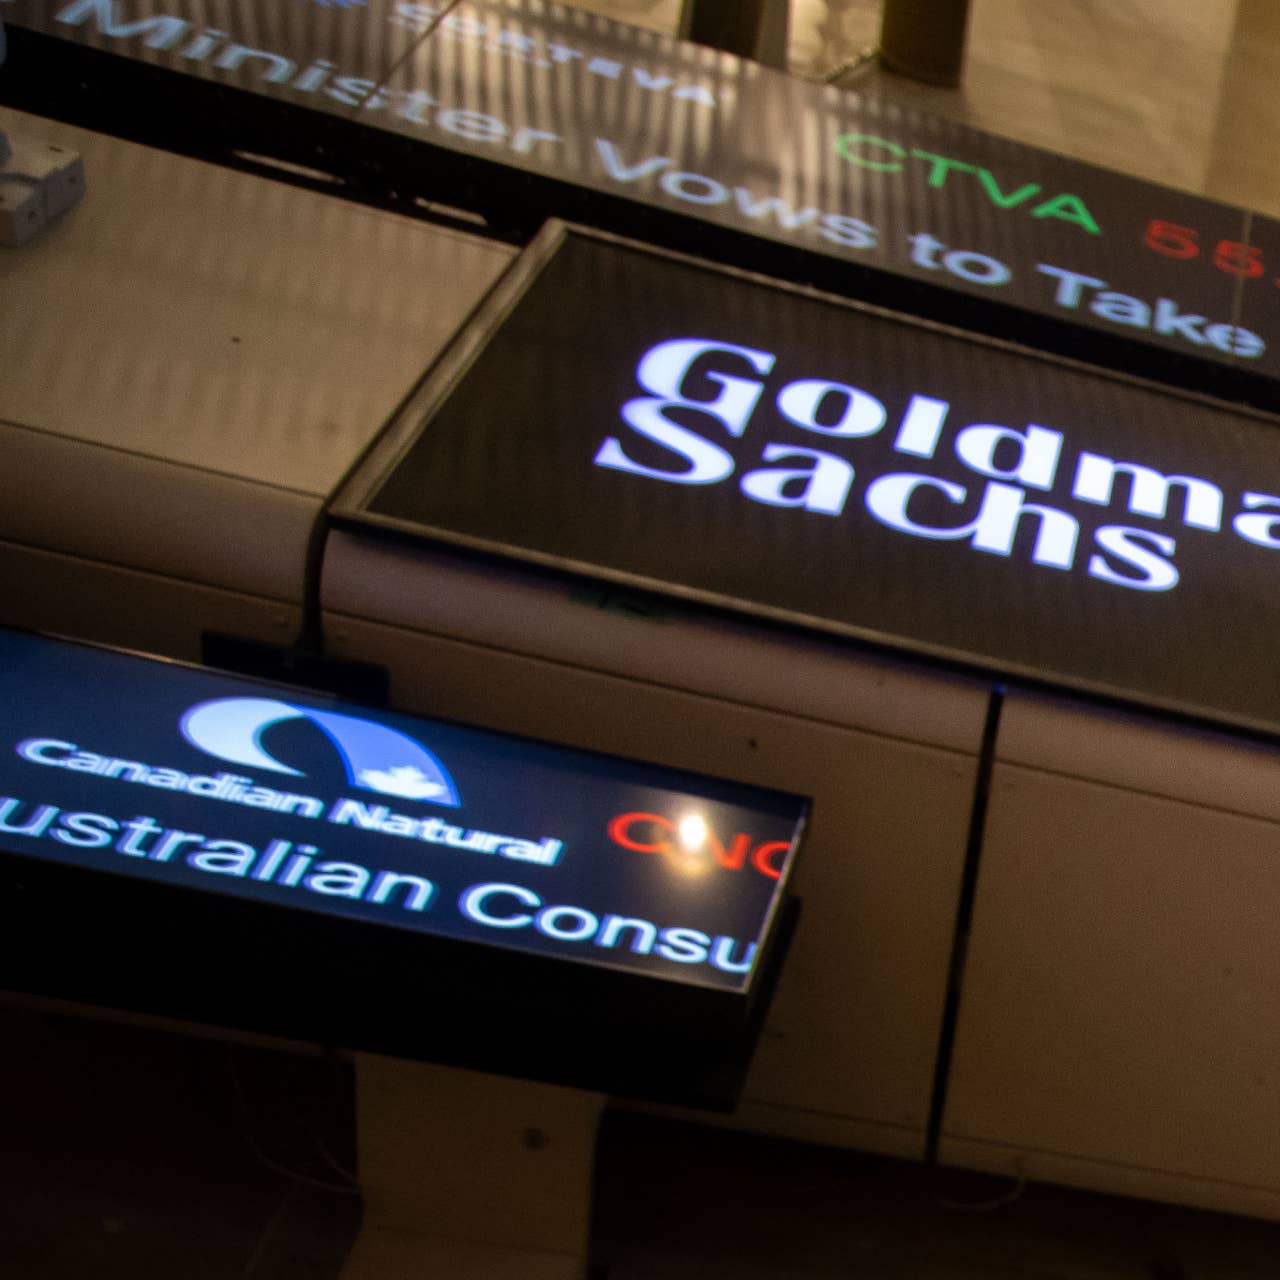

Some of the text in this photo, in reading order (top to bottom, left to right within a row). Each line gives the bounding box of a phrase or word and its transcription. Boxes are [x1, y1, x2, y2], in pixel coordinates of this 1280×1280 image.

[55, 0, 562, 153] Minister
[595, 137, 877, 249] Vows
[907, 231, 1012, 286] to
[1036, 262, 1266, 358] Take
[834, 133, 1100, 235] CTVA
[592, 396, 1180, 592] Sachs
[15, 737, 322, 818] Canadian
[328, 798, 566, 866] Natural
[457, 881, 758, 973] Consu
